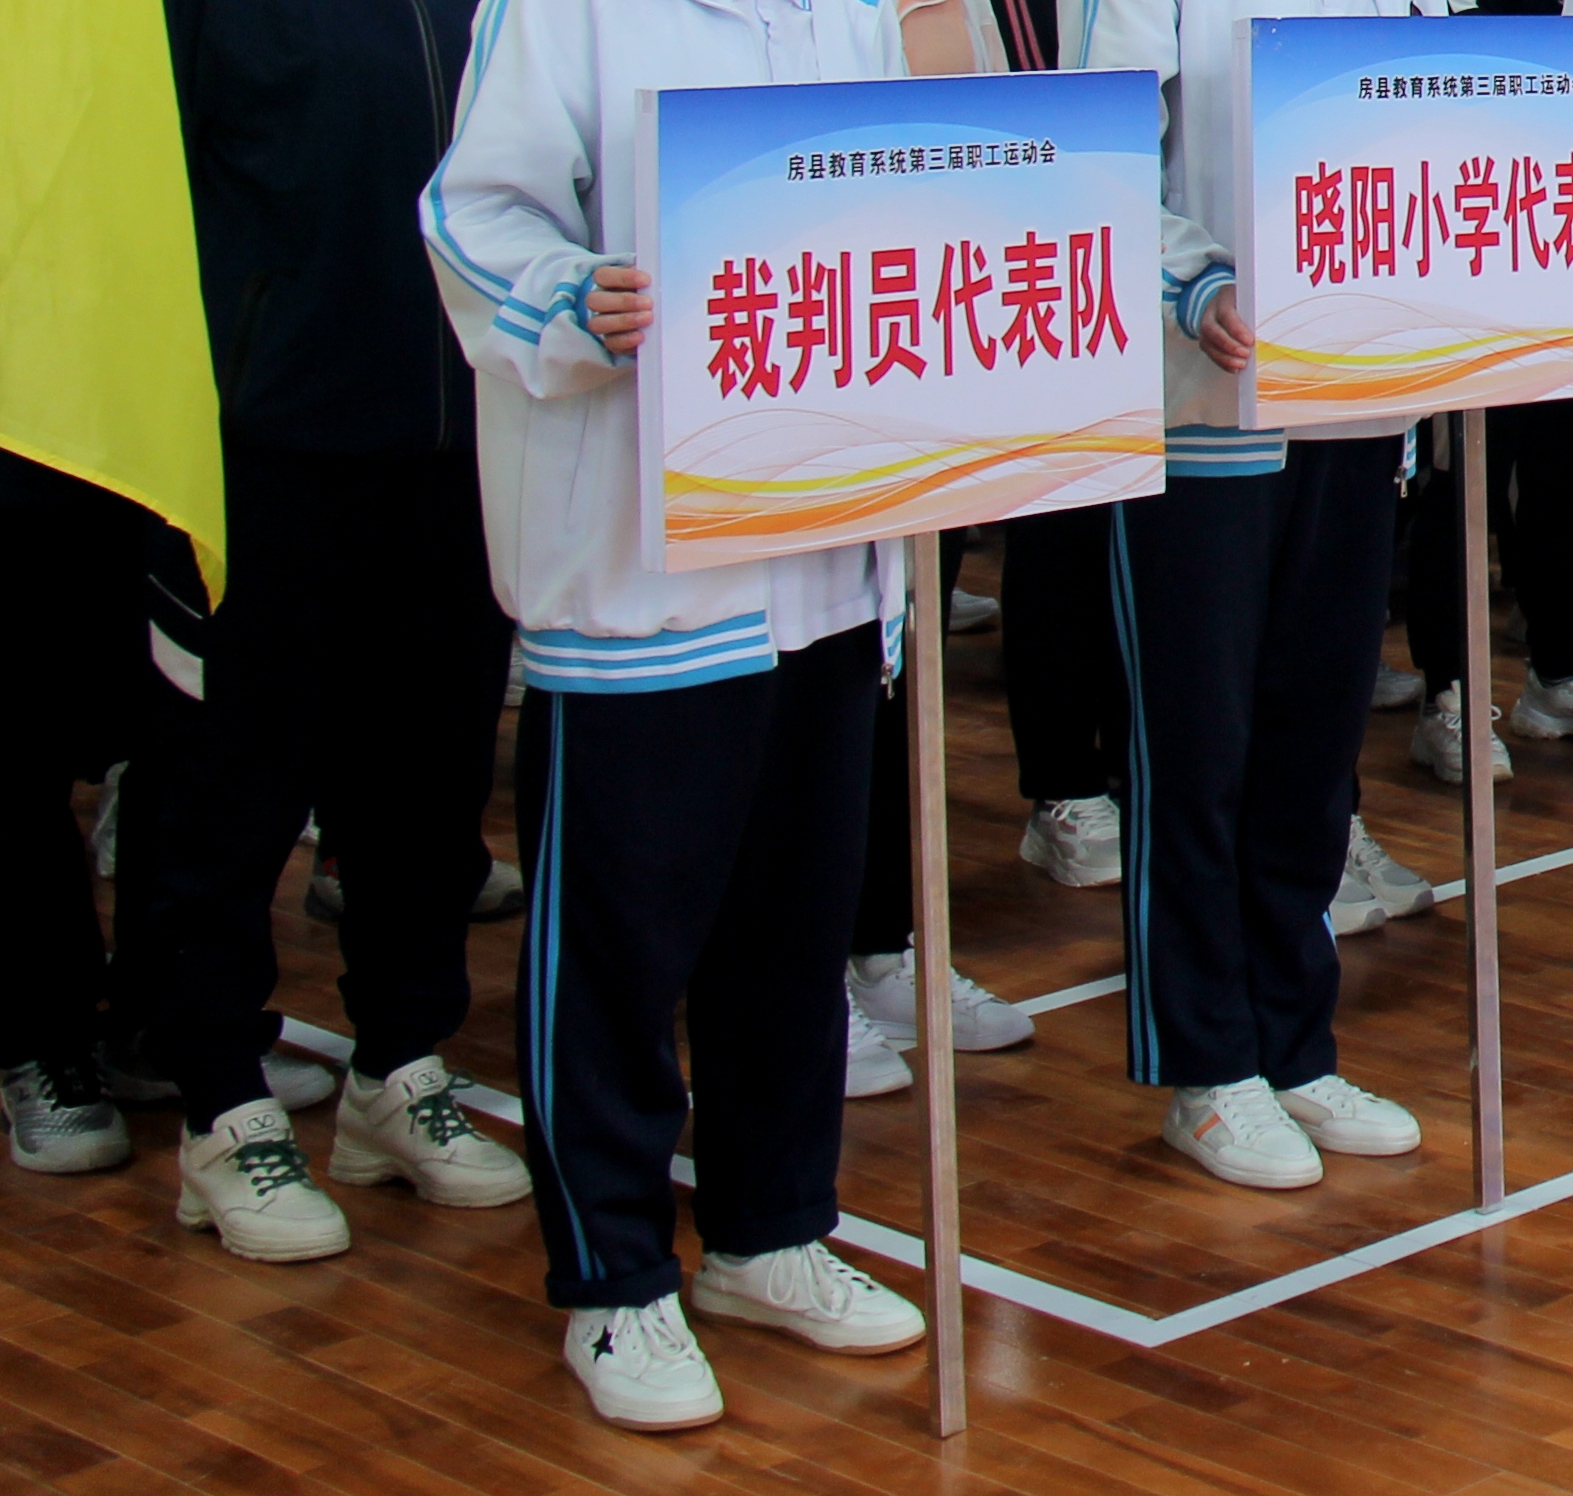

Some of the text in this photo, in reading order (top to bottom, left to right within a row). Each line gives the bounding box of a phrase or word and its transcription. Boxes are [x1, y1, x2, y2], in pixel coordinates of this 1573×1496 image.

[788, 140, 1055, 180] 房县教育系统第三届职工运动会
[707, 226, 1129, 401] 裁判员代表队
